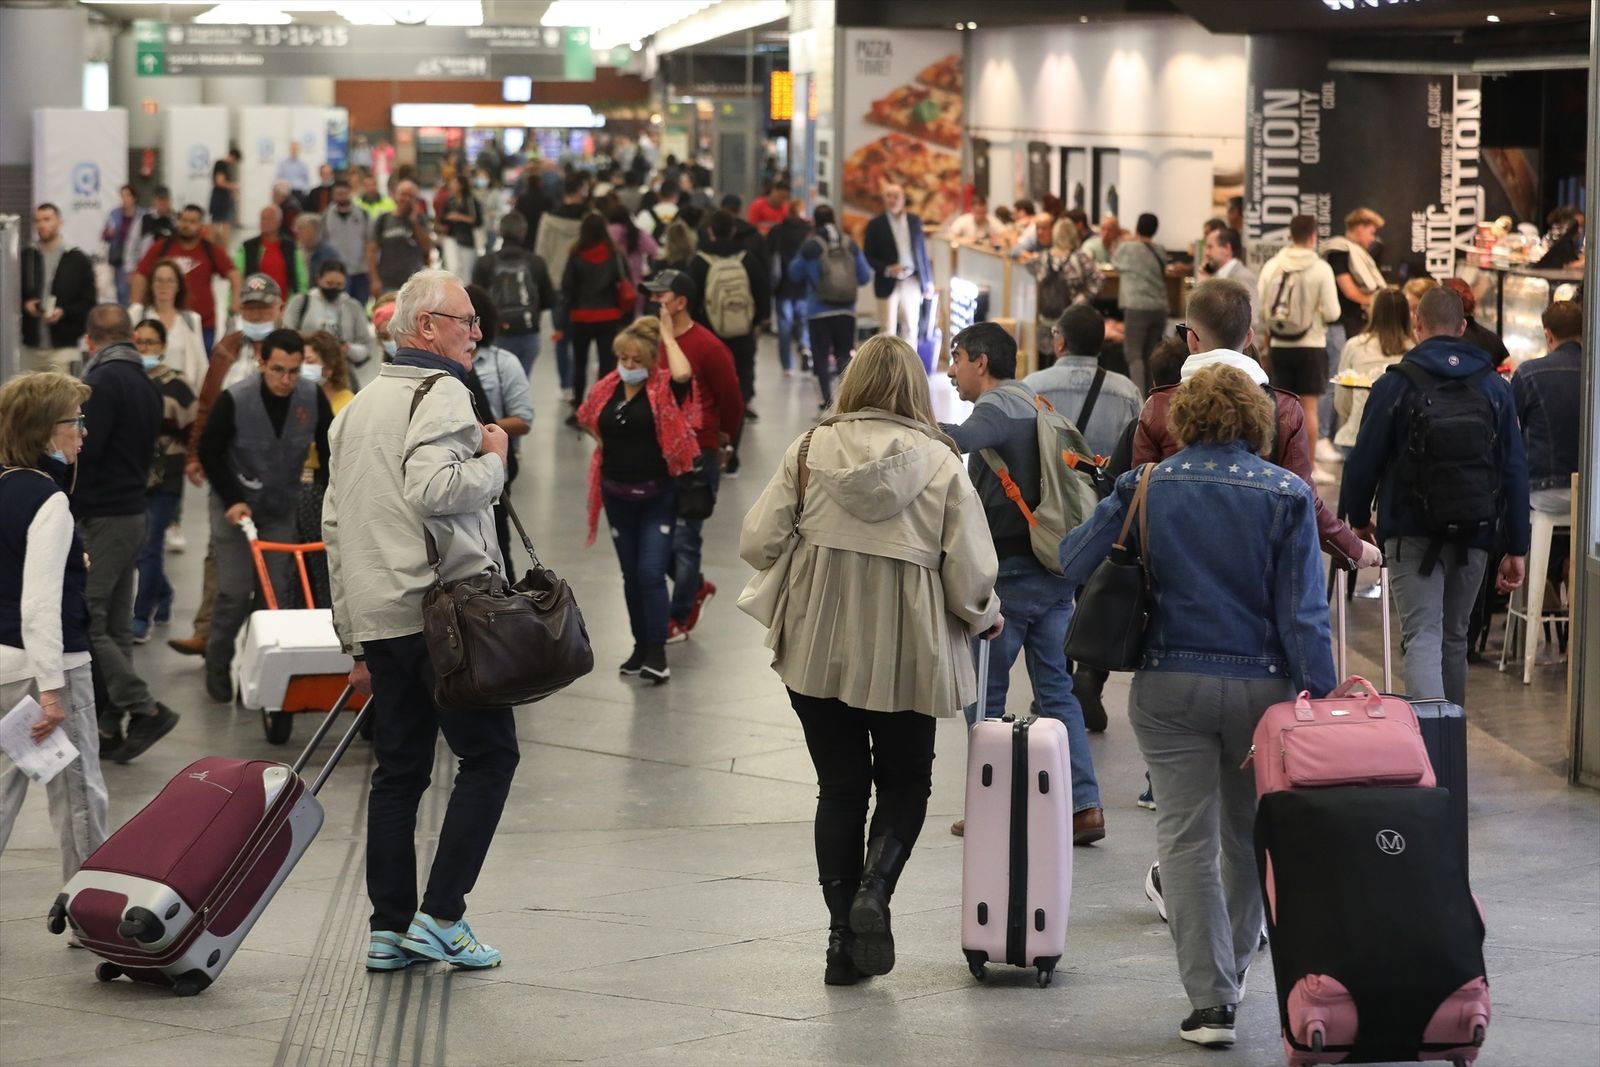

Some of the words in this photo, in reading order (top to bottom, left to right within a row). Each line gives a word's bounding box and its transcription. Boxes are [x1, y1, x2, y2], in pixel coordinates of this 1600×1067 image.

[855, 38, 893, 58] PIZZA
[1300, 89, 1320, 164] QUALITY
[1440, 111, 1452, 146] STYLE
[1440, 146, 1452, 176] YORK
[1411, 210, 1426, 253] SIMPLE
